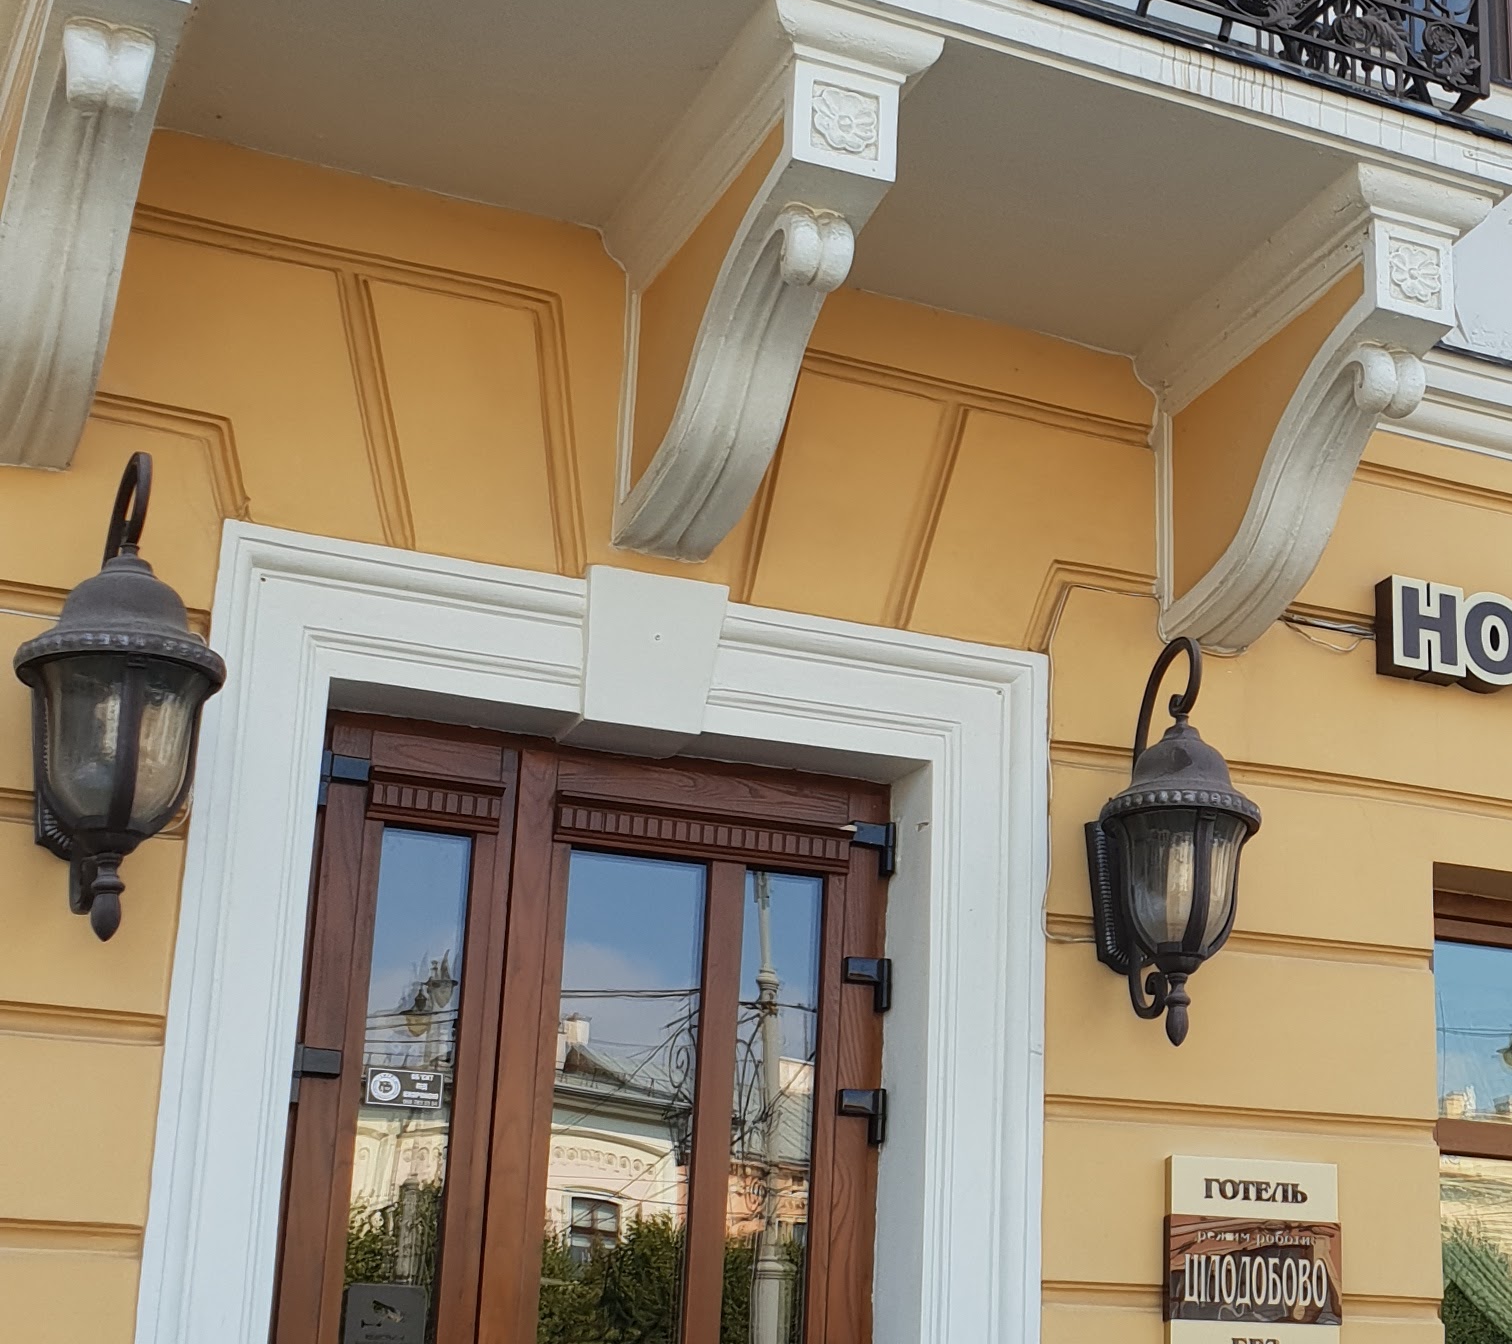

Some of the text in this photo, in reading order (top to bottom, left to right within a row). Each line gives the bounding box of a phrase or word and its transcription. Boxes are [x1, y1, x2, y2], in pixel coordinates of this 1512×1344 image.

[1204, 1177, 1309, 1205] ГОТЕЛЬ
[1197, 1230, 1251, 1243] режим
[1184, 1253, 1328, 1309] ЦІЛОДОБОВО
